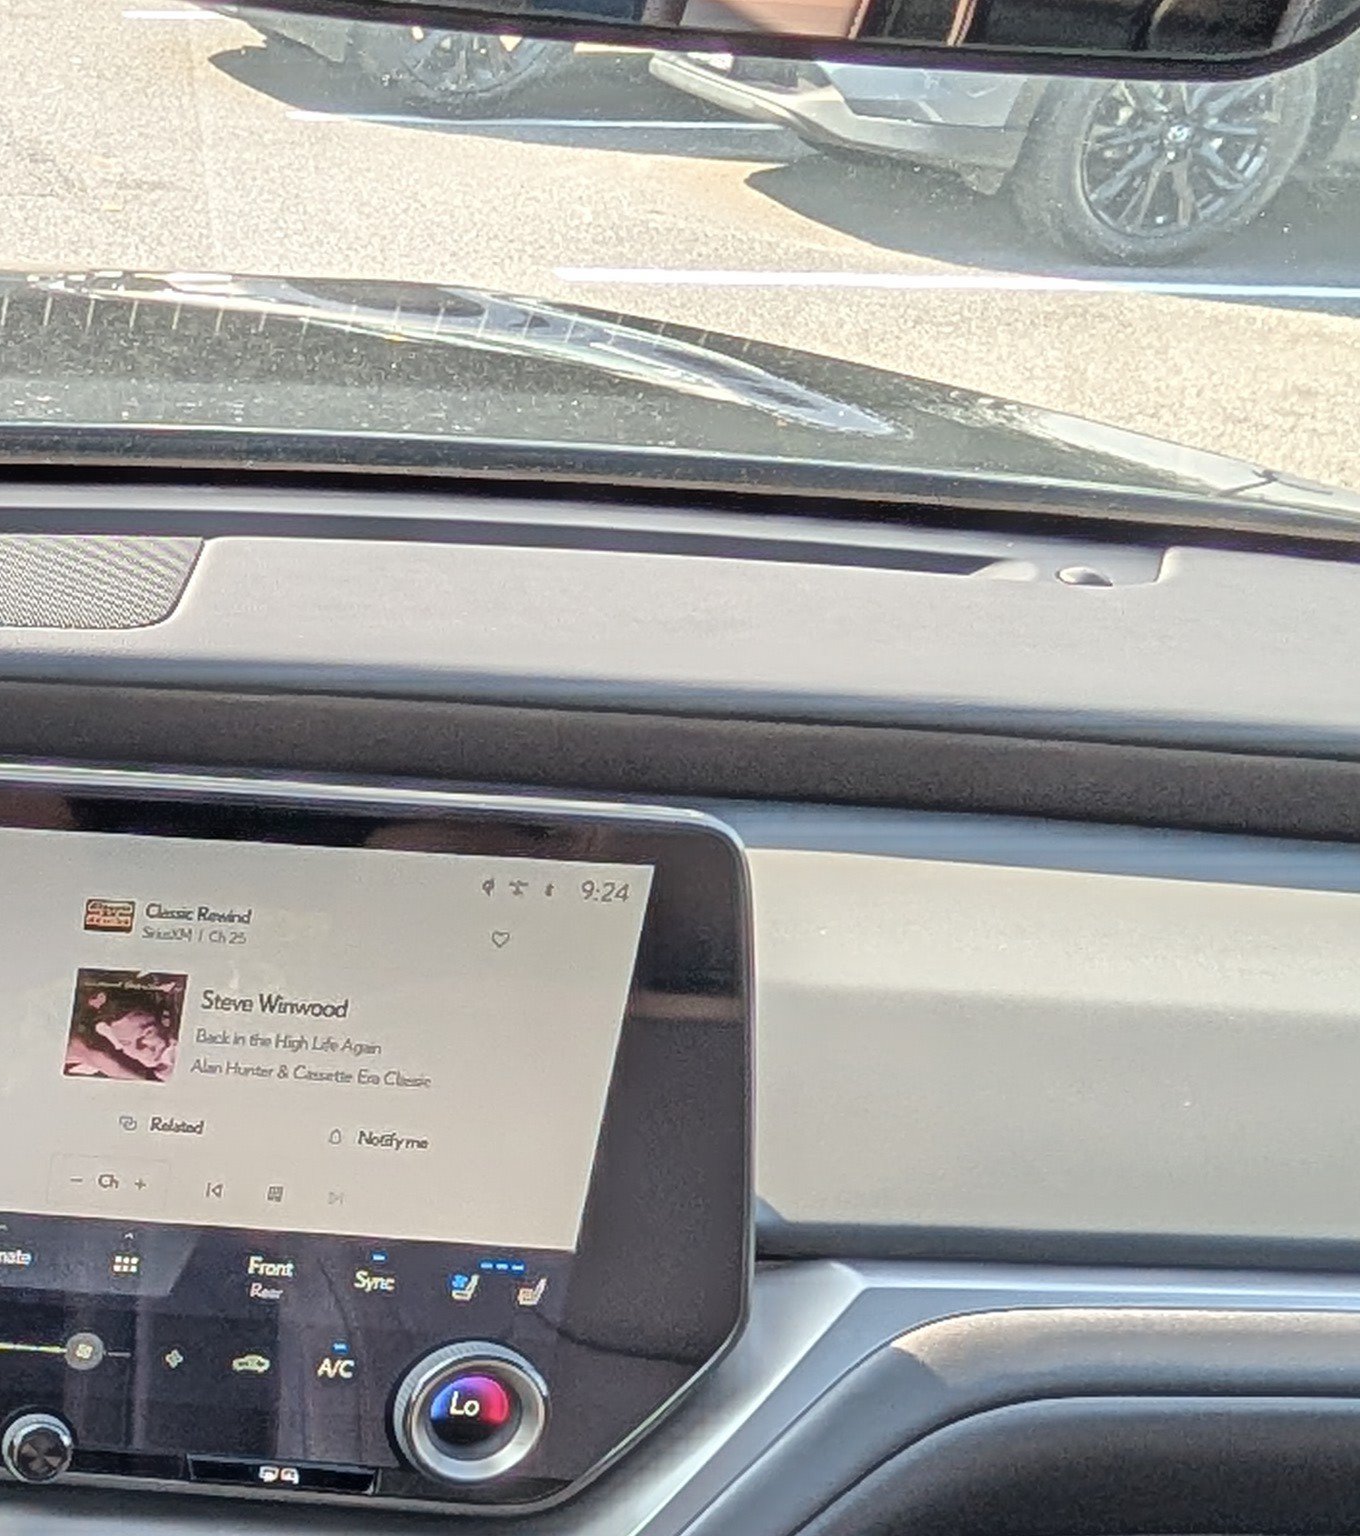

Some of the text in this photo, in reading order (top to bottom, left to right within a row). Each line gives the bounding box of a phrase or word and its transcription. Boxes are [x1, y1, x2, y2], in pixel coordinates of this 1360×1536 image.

[581, 879, 631, 904] 9:24
[145, 903, 194, 921] Classic
[197, 906, 252, 925] Rewind
[209, 930, 227, 944] Ch
[201, 990, 349, 1018] Steve Winwood
[196, 1028, 383, 1057] Back in the High Life Again
[190, 1058, 223, 1076] Alan
[226, 1061, 273, 1079] Hunter
[276, 1063, 288, 1080] &
[293, 1065, 352, 1084] Cassette
[150, 1117, 205, 1135] Related
[357, 1130, 429, 1151] Notify me
[98, 1173, 119, 1190] Ch
[248, 1256, 294, 1278] Front
[250, 1282, 284, 1301] Rear
[354, 1270, 395, 1293] Sync
[317, 1358, 356, 1380] A/C
[449, 1390, 480, 1417] Lo
